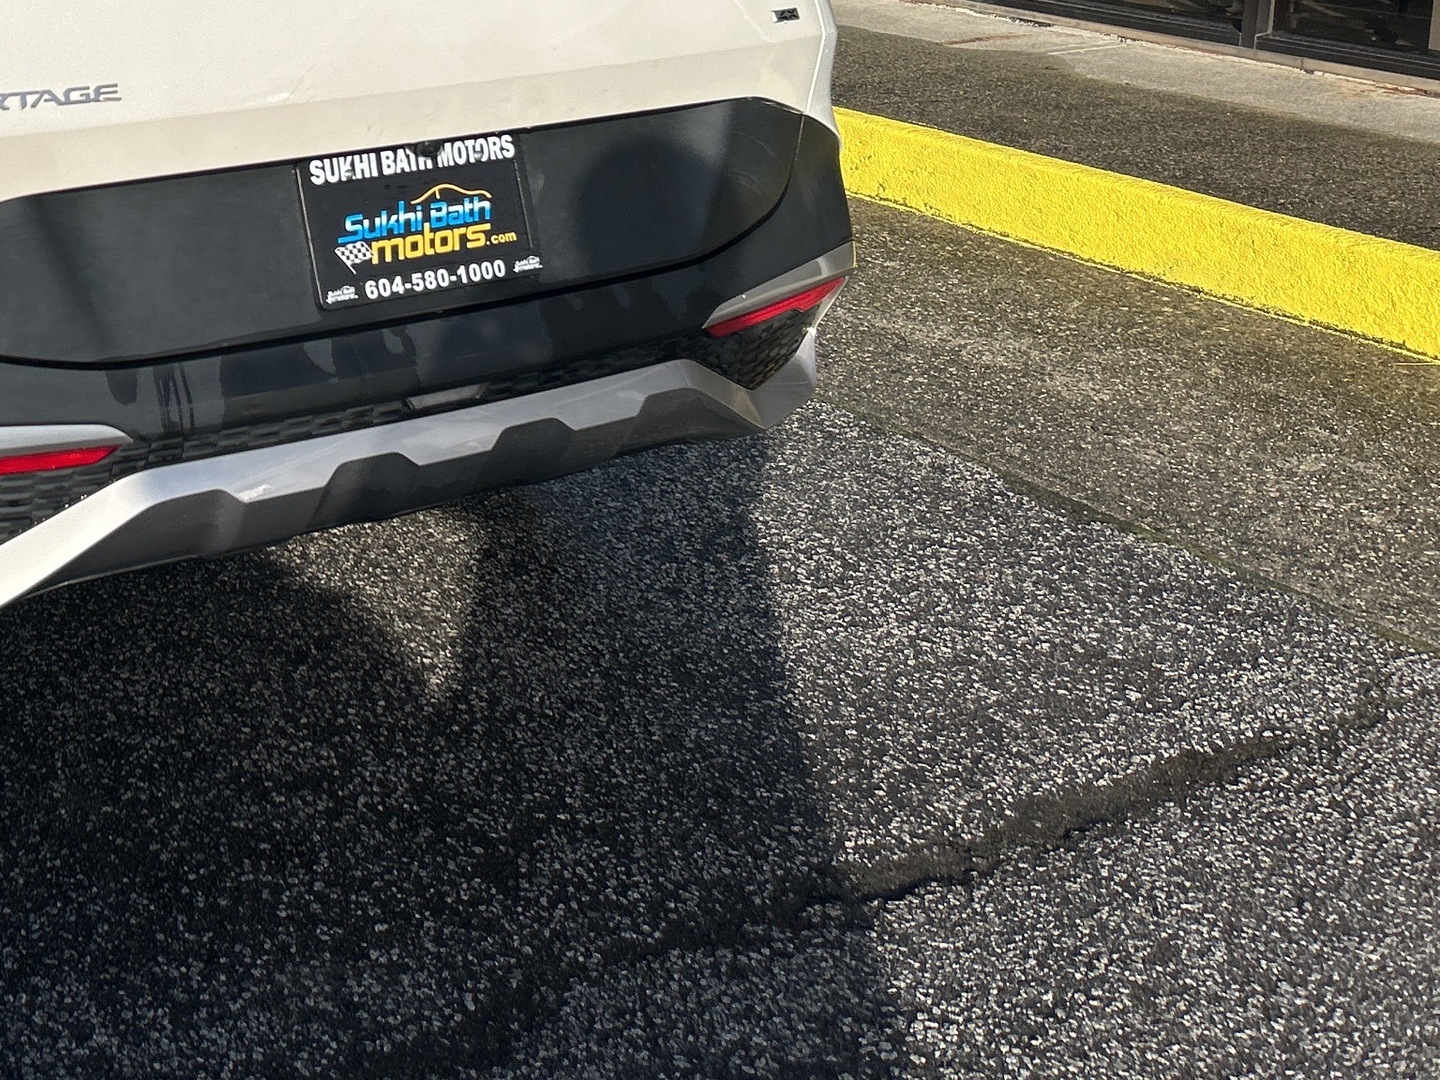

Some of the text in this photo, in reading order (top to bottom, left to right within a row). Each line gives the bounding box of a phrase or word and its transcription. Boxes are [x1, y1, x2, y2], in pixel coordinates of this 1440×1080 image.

[309, 152, 378, 185] SUKHI
[437, 134, 516, 168] MOTORS
[337, 196, 493, 244] Sukhi Bath
[364, 259, 506, 299] 604-580-1000
